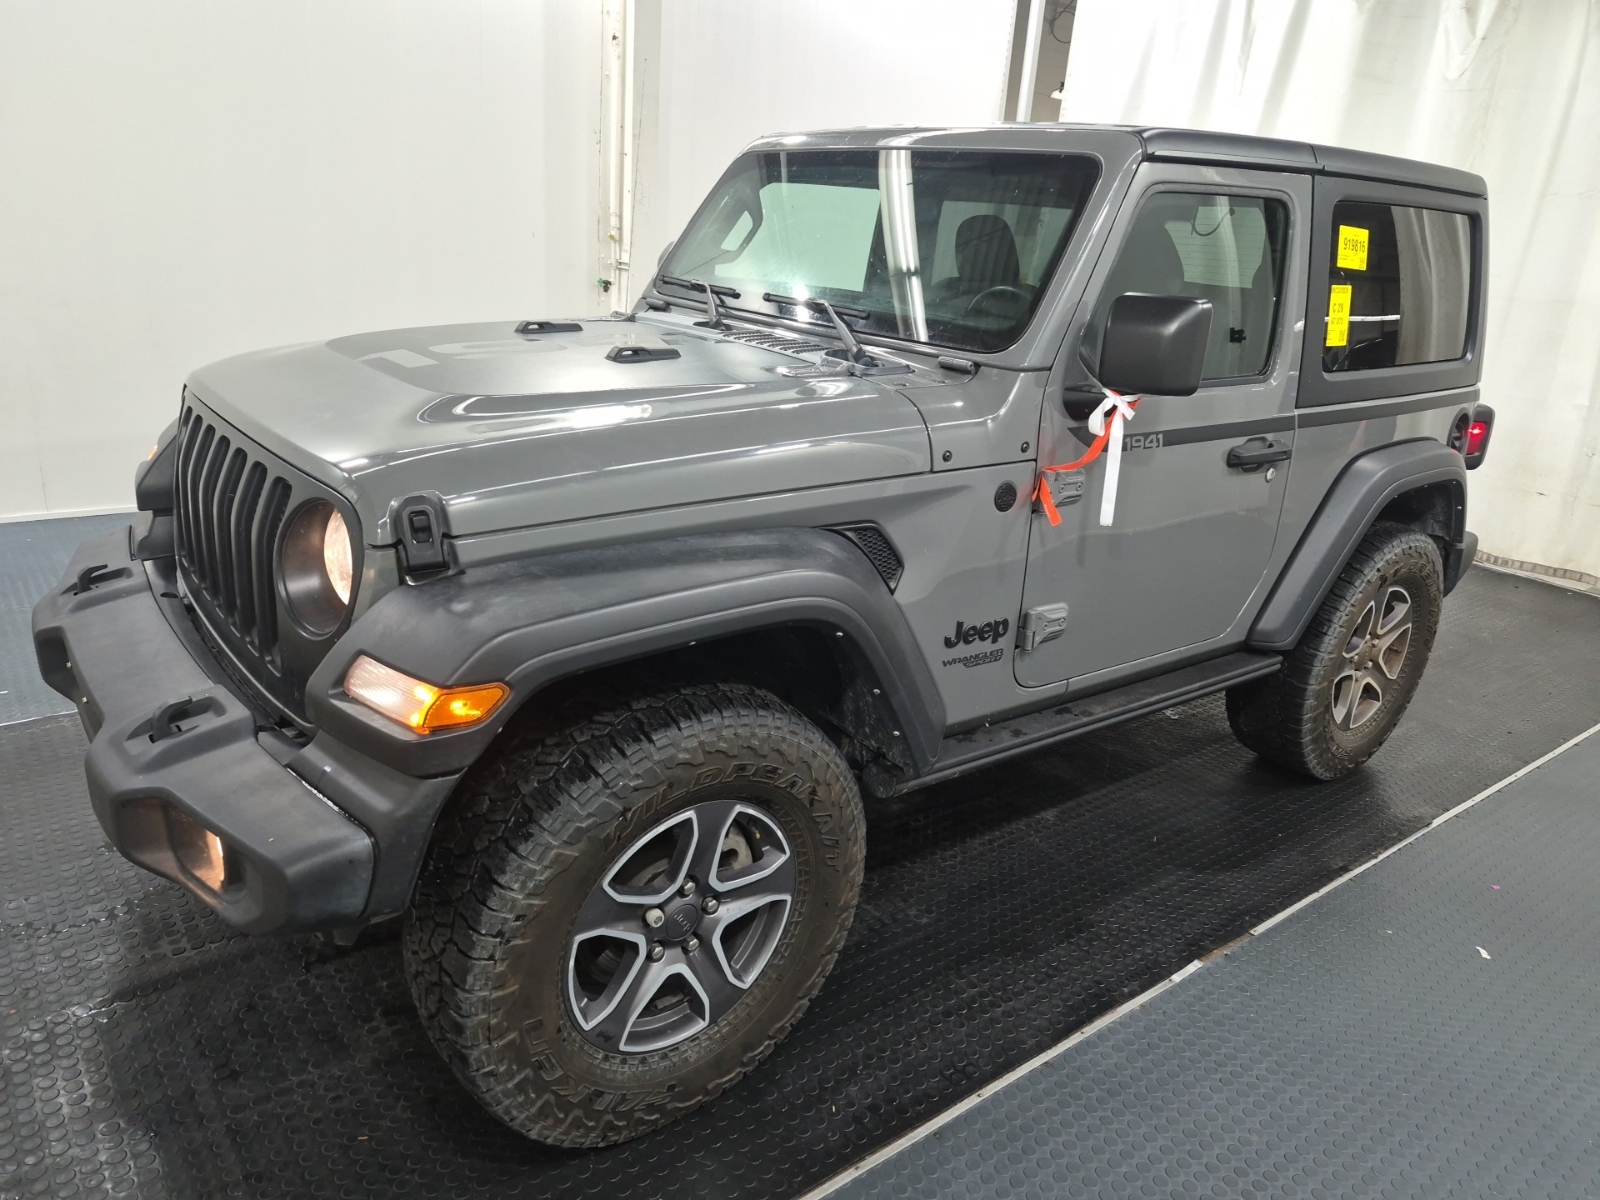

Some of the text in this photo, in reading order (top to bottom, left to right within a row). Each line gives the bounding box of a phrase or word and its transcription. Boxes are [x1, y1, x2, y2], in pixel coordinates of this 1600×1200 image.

[1343, 237, 1366, 253] 919816
[1124, 433, 1163, 452] 1941
[944, 617, 1009, 649] Jeep
[941, 648, 1004, 668] WRANGLER
